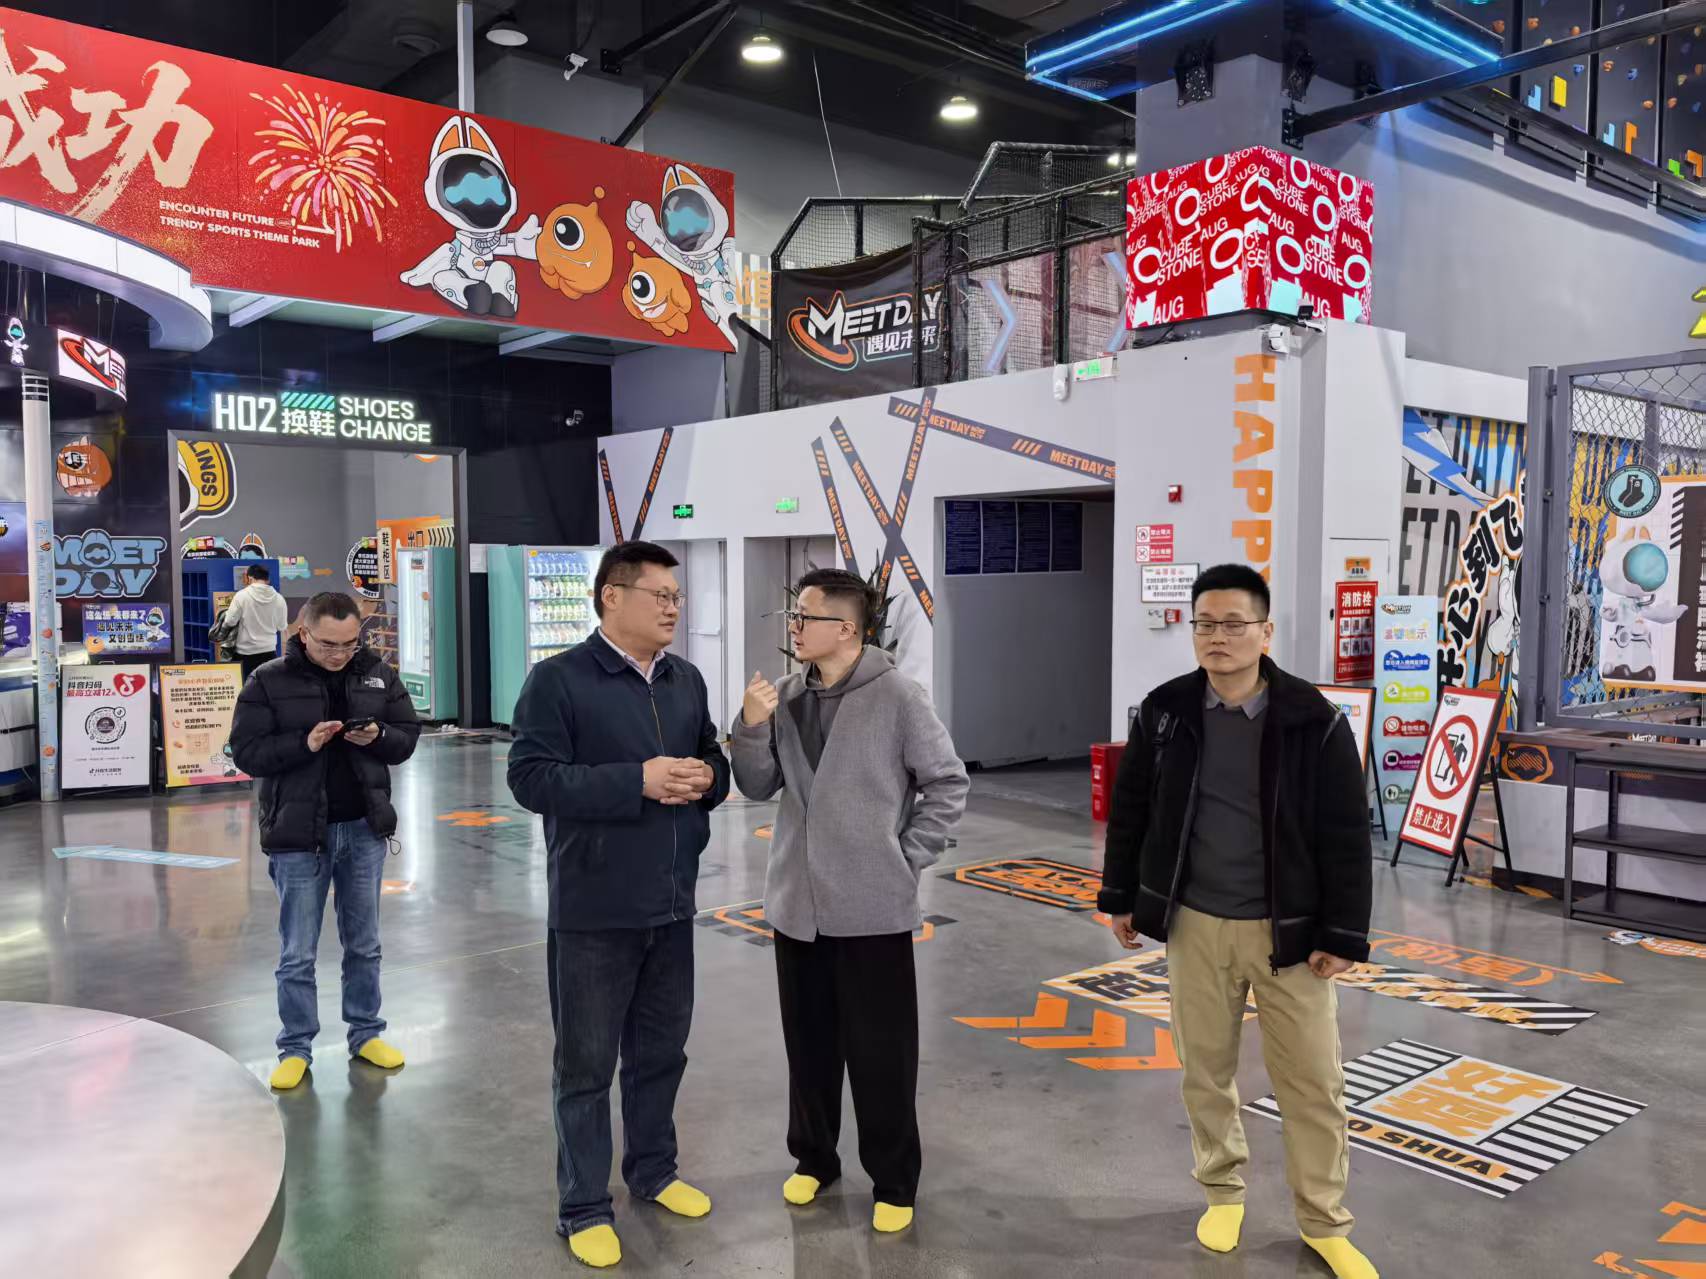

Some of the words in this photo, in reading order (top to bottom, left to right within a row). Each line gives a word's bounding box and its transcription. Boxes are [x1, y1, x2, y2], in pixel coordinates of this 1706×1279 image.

[1199, 176, 1230, 204] CUBE
[1199, 182, 1240, 216] STONE
[1274, 186, 1309, 217] STONE
[1277, 178, 1306, 202] CUBE
[1309, 178, 1329, 196] AUG
[159, 200, 230, 220] ENCOUNTER
[232, 211, 275, 227] FUTURE
[1268, 212, 1294, 236] AUG
[160, 215, 204, 231] TRENDY
[207, 223, 251, 238] SPORTS
[253, 229, 289, 244] THEME
[292, 236, 320, 249] PARK
[1201, 217, 1228, 242] AUG
[1341, 231, 1363, 254] AUG
[1159, 239, 1194, 268] CUBE
[1305, 236, 1336, 266] CUBE
[1156, 247, 1202, 286] STONE
[1304, 252, 1344, 287] STONE
[1154, 295, 1184, 324] AUG
[339, 396, 415, 421] SHOES
[281, 409, 336, 438] 换鞋
[339, 417, 432, 444] CHANGE
[905, 417, 928, 481] MEETDAY
[1049, 448, 1104, 476] MEETDAY
[1231, 354, 1277, 583] HAPP
[852, 460, 882, 514] MEETDAY
[826, 487, 848, 541] MEETDAY
[1341, 591, 1373, 608] 消防栓
[1411, 807, 1451, 835] 禁止进入
[1383, 1130, 1496, 1177] SHUA
